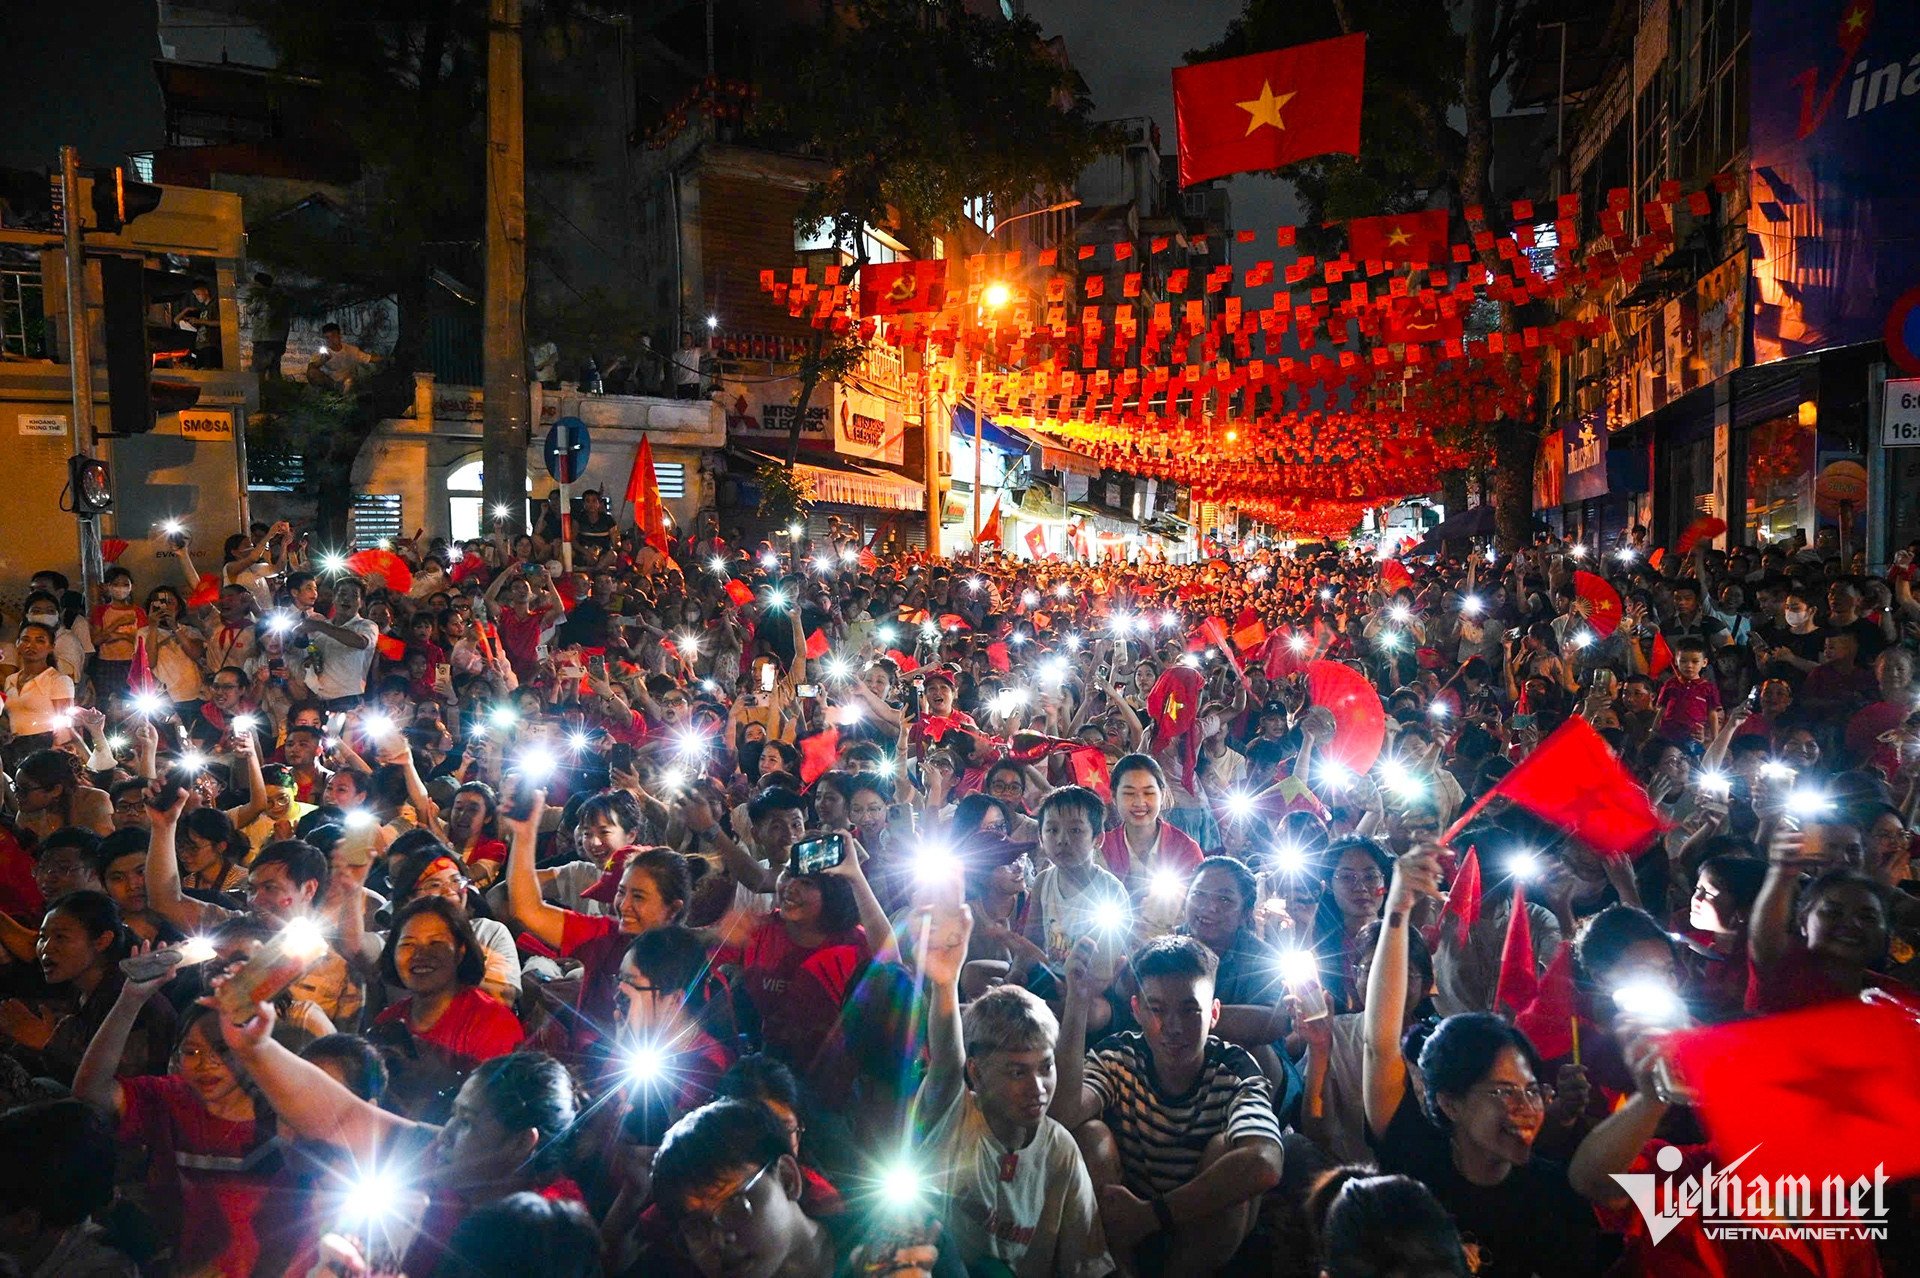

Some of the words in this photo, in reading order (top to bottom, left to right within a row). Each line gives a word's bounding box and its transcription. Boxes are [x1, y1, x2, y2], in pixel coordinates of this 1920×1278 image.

[763, 404, 829, 420] MITSISHI
[183, 418, 230, 432] SMOSA
[764, 418, 824, 432] ELECRIC
